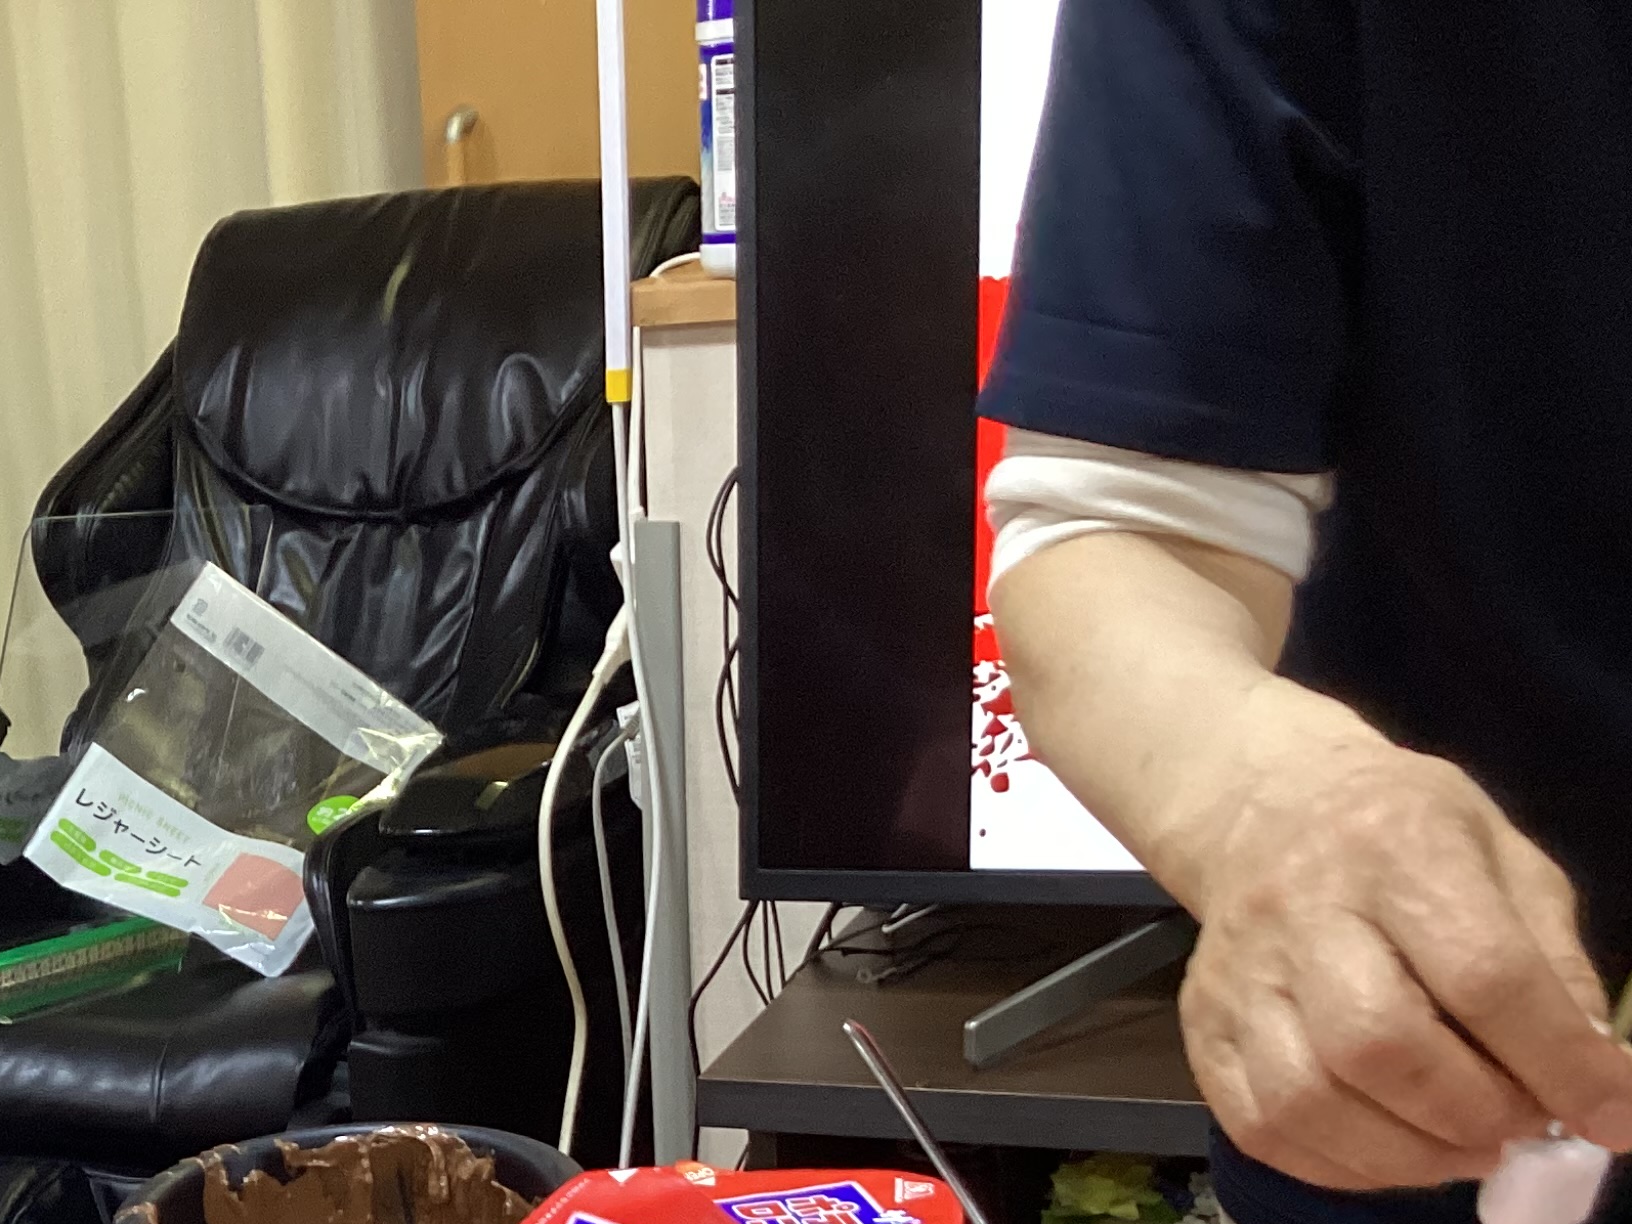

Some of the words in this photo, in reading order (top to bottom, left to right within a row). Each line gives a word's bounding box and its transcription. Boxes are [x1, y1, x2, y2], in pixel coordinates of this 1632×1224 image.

[75, 788, 202, 867] レジャーシート
